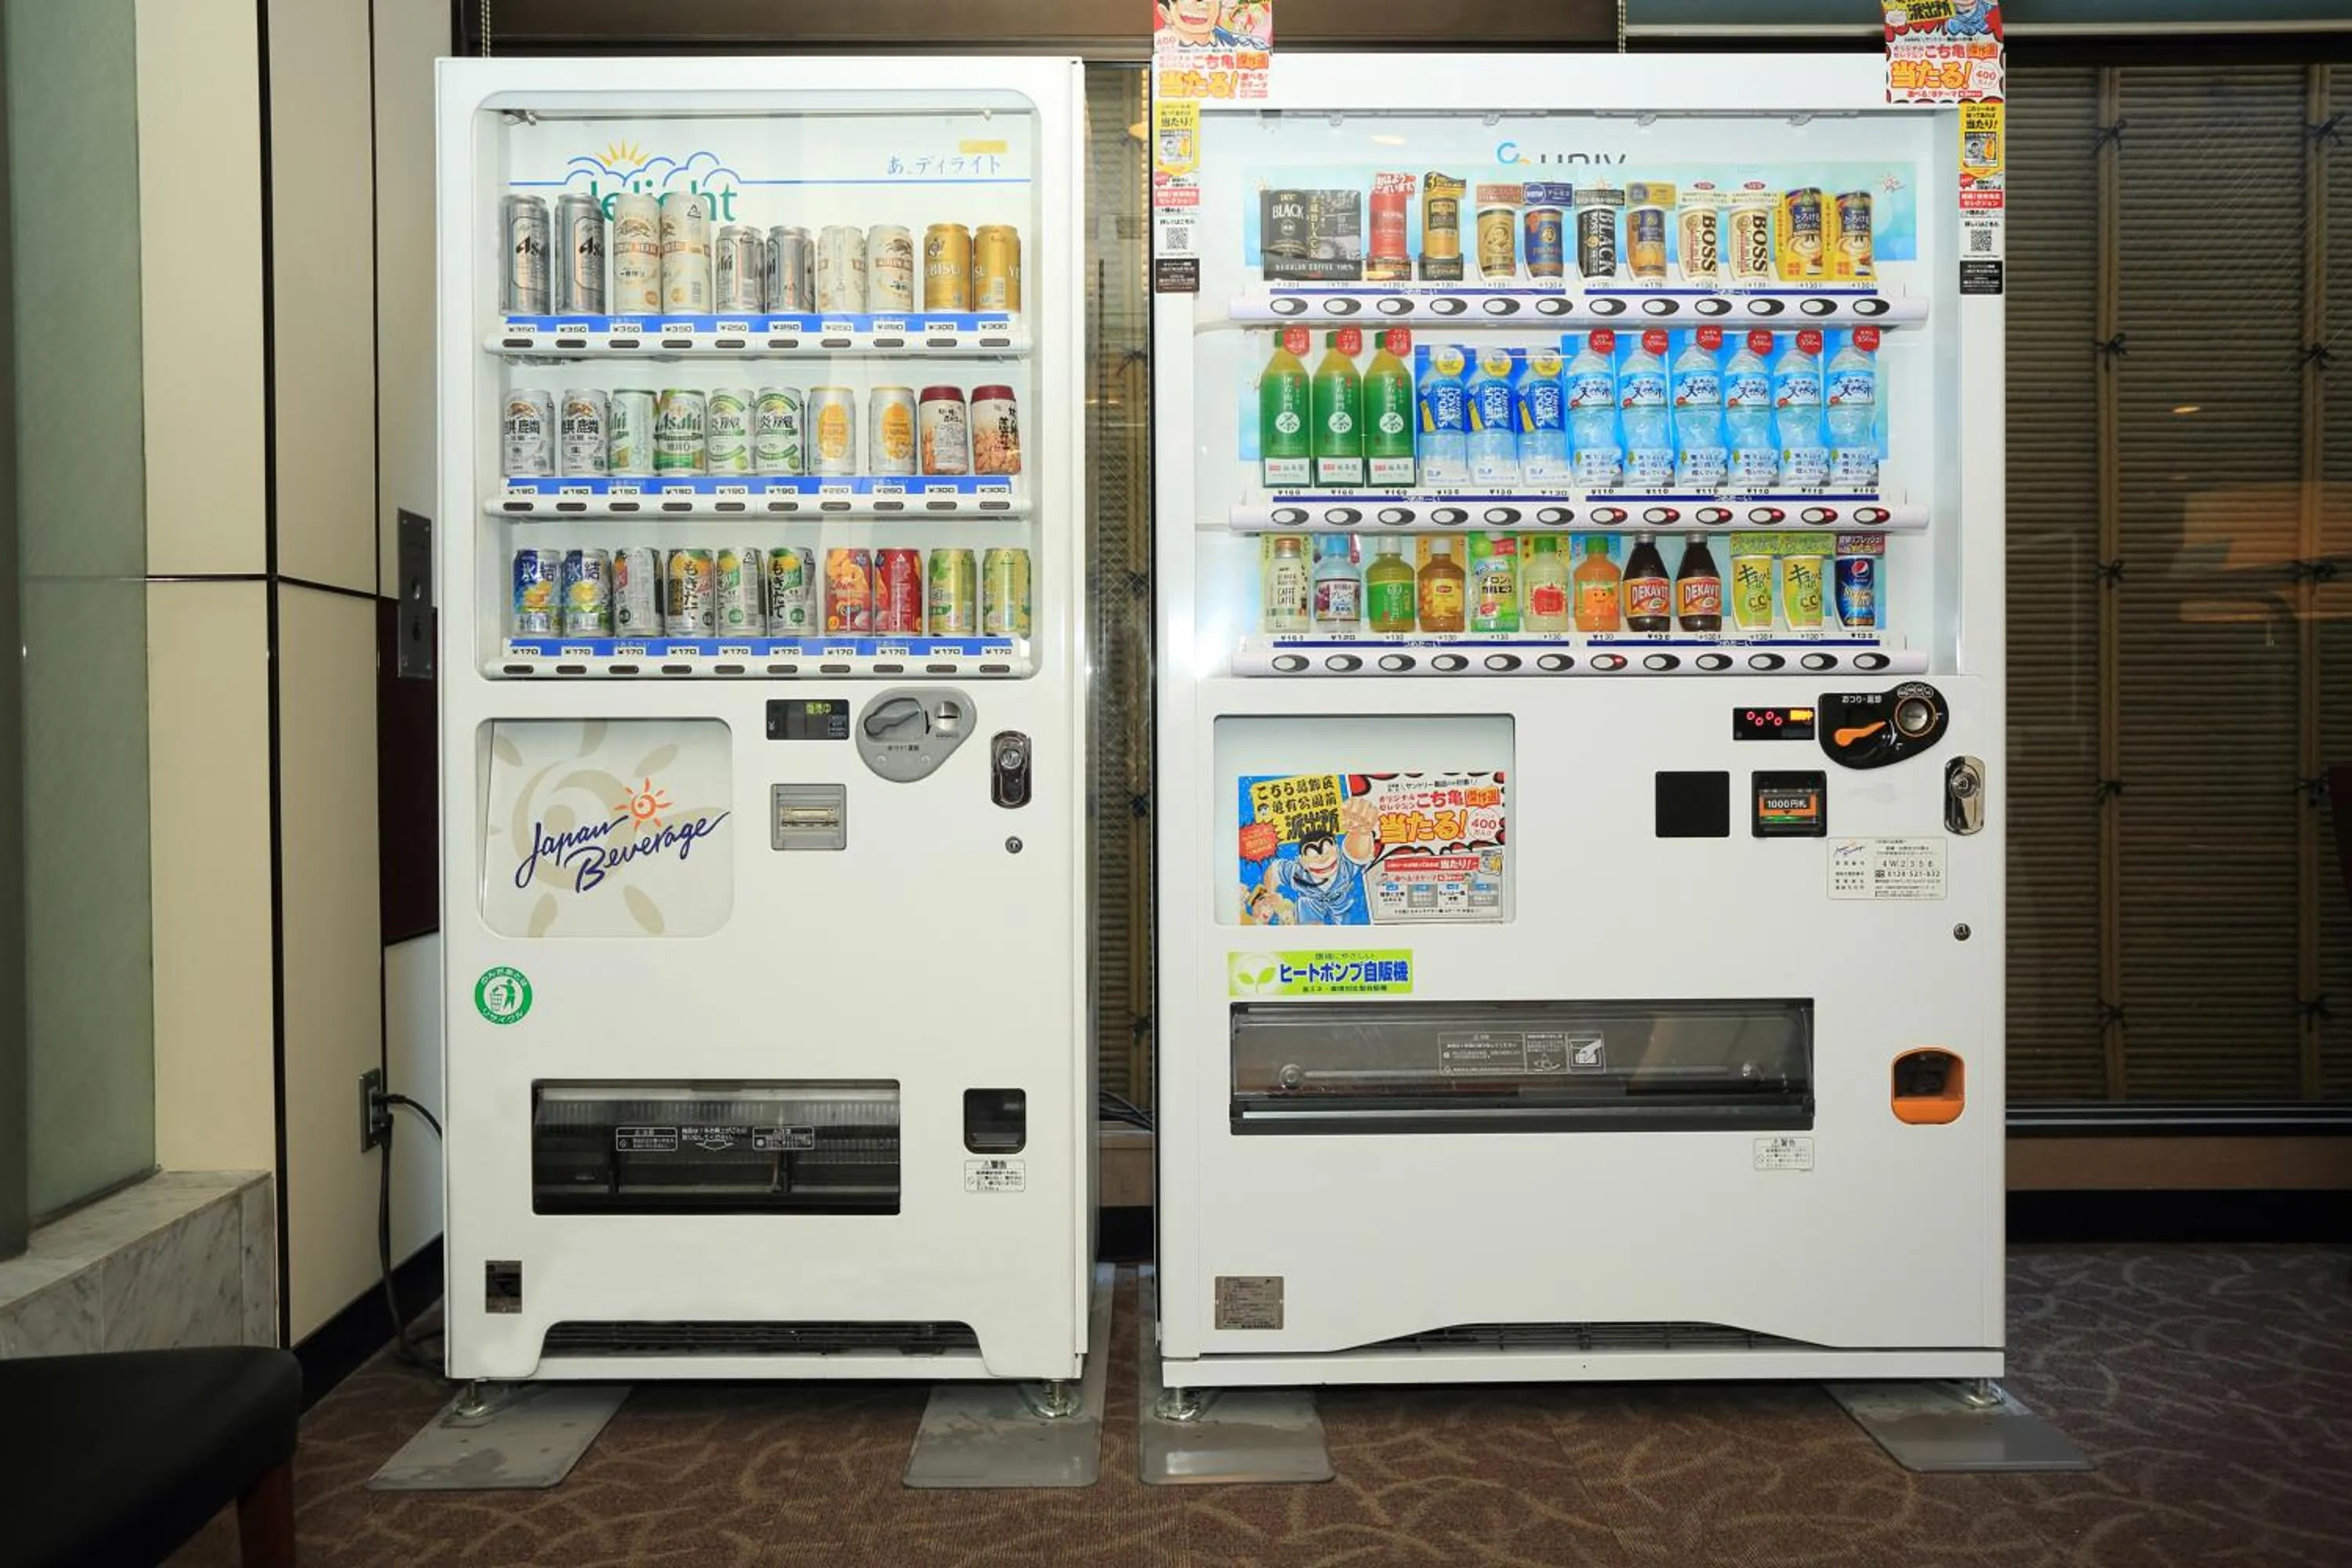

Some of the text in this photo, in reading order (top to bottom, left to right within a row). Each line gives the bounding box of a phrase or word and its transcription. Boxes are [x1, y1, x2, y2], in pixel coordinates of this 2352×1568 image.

[1272, 204, 1304, 220] BLACK
[1702, 213, 1717, 273] BOSS
[1752, 213, 1768, 273] BOSS
[1415, 789, 1463, 808] こち亀
[1469, 820, 1495, 831] 400
[515, 815, 630, 889] Japan
[564, 811, 731, 894] Beverage
[1279, 960, 1409, 984] ヒートポンプ自販機
